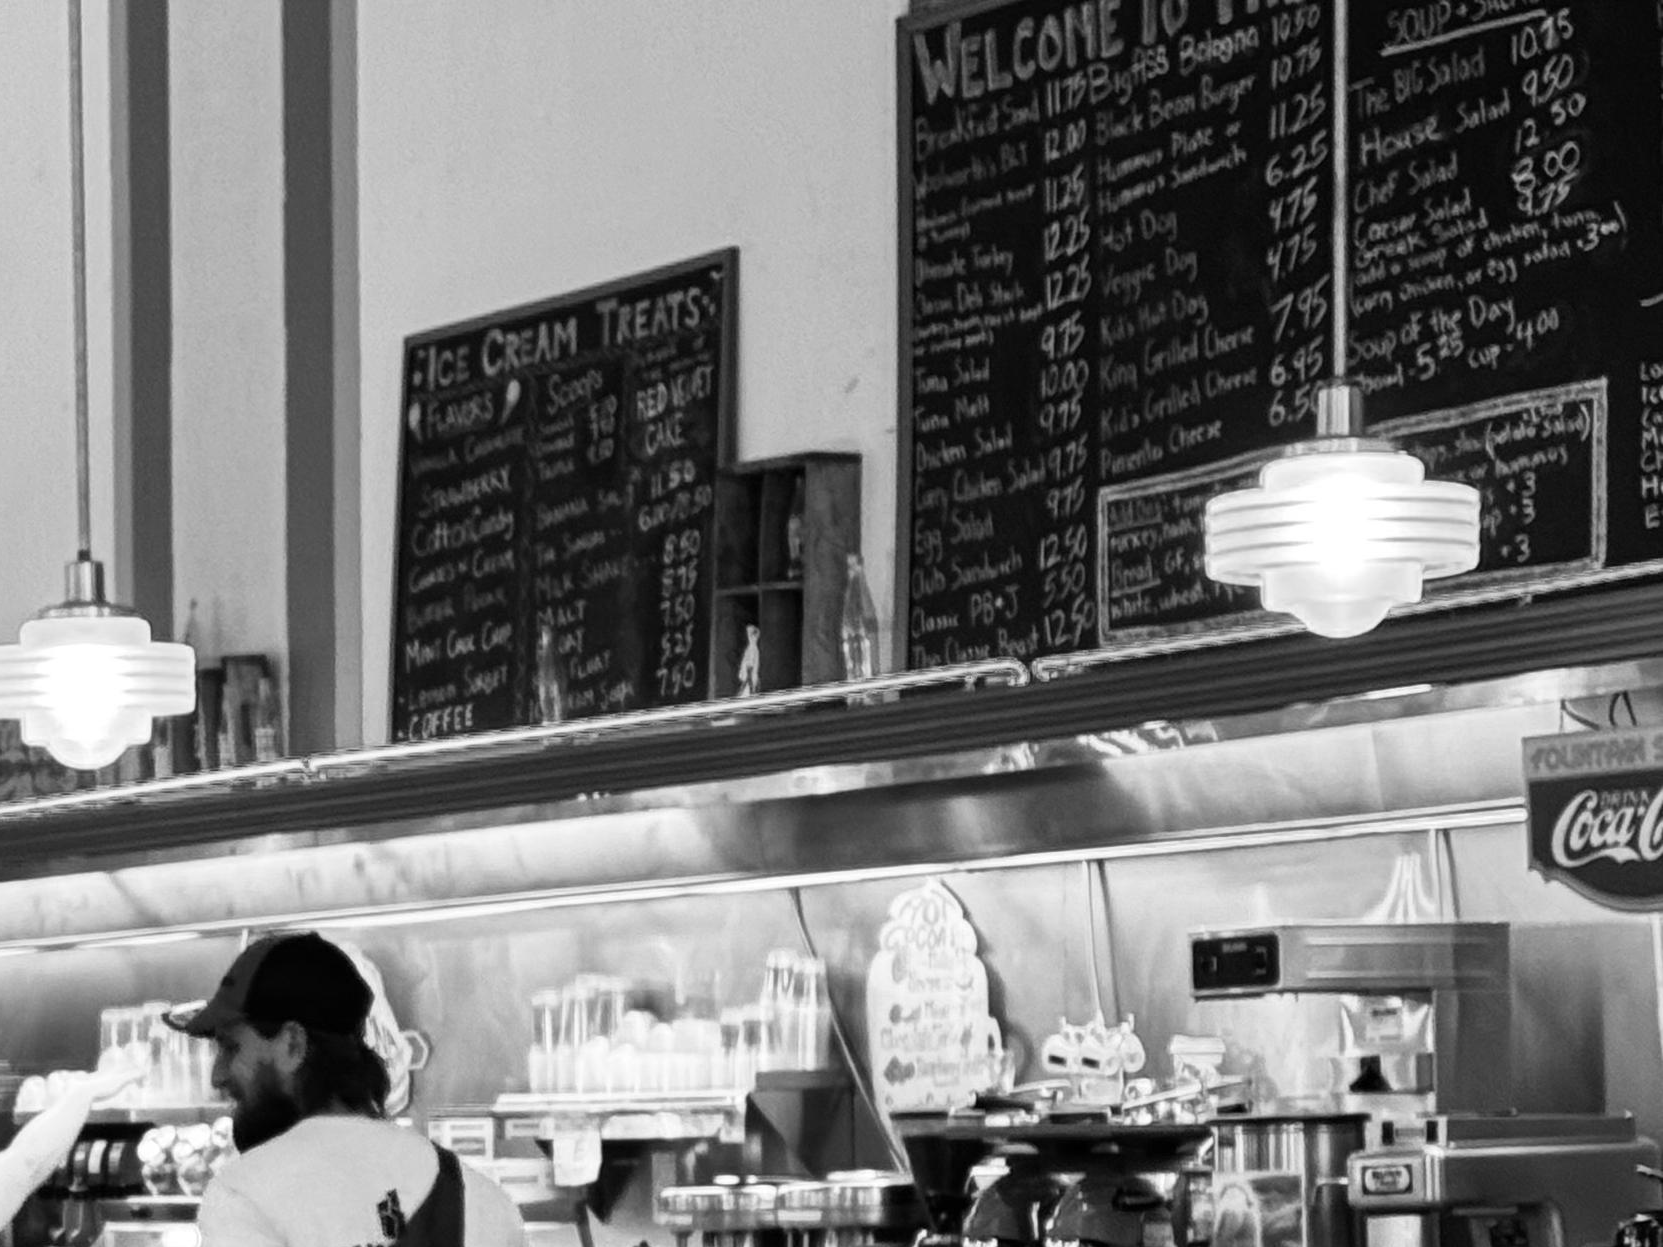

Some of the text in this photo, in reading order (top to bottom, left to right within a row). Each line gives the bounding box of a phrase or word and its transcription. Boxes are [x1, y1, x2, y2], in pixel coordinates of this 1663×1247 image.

[913, 0, 1125, 105] WELCOME
[1428, 46, 1486, 95] Salad
[1149, 87, 1197, 129] Bean
[1359, 115, 1443, 167] House
[1455, 87, 1511, 134] Salad
[1407, 151, 1458, 196] Salad
[1099, 217, 1134, 252] Hot
[1141, 207, 1179, 243] Dog
[1164, 246, 1198, 283] Dog
[1171, 289, 1209, 326] Dog
[1468, 294, 1517, 336] Day
[427, 345, 470, 392] ICE
[481, 316, 578, 378] CREAM
[595, 286, 703, 347] TREATS
[645, 411, 689, 457] CAKE
[408, 702, 475, 741] COFFEE
